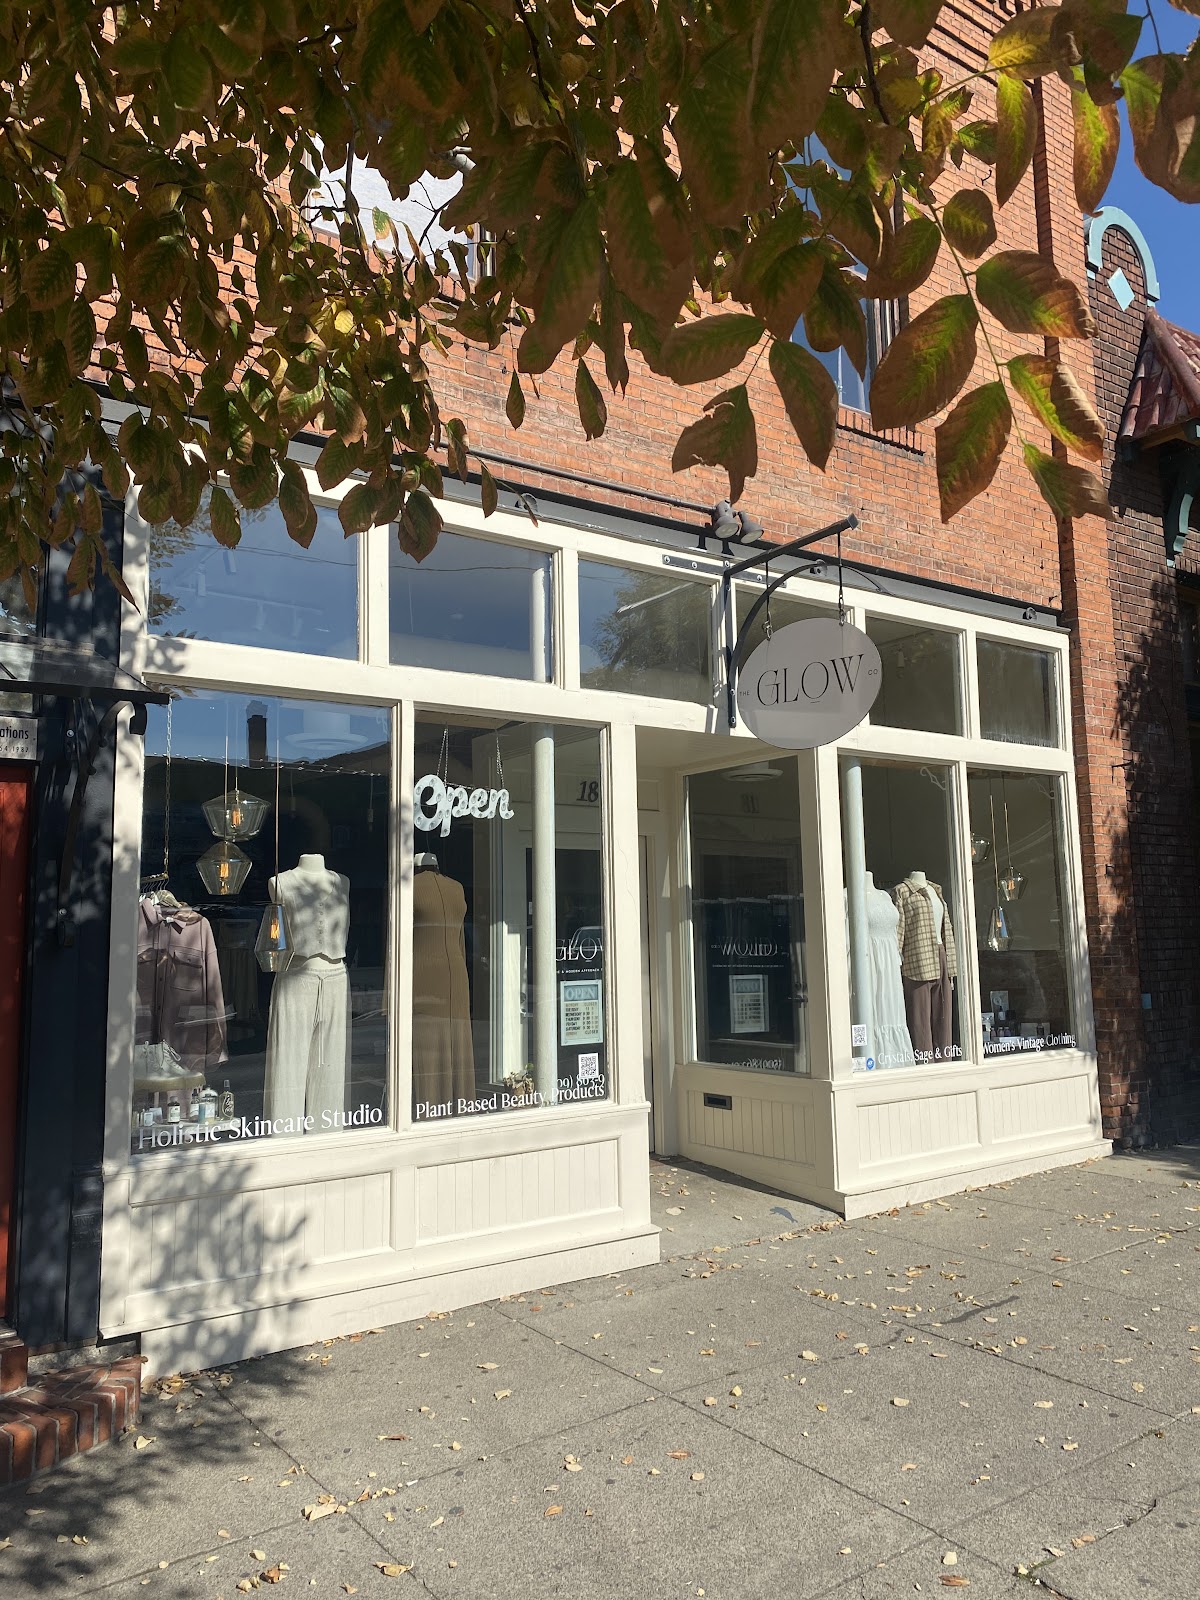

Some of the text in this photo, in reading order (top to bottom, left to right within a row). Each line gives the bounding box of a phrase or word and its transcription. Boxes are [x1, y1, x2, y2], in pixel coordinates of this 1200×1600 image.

[757, 654, 865, 706] GLOW
[413, 774, 514, 838] Open
[576, 780, 599, 803] 18
[566, 987, 596, 999] OPEN
[914, 1049, 933, 1064] Sage
[935, 1047, 942, 1059] &
[944, 1045, 963, 1058] Gifts
[983, 1033, 1076, 1055] Women's Vintage Clothing
[415, 1083, 605, 1119] Plant Based Beauty Products
[138, 1104, 383, 1150] Holistic Skincare Studio
